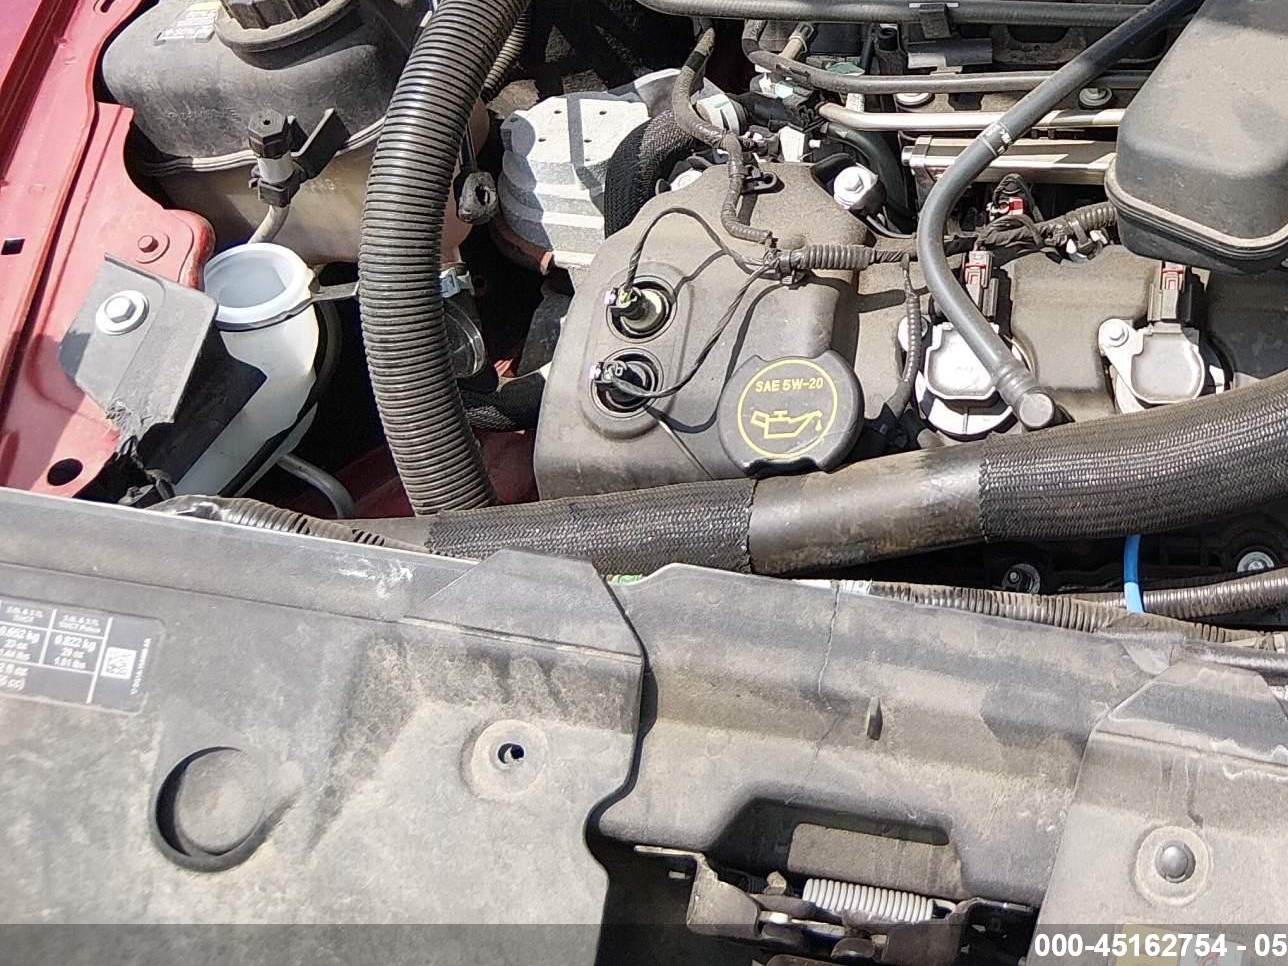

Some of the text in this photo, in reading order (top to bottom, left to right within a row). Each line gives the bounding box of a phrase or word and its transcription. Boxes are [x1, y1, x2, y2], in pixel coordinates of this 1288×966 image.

[755, 377, 824, 393] SAE 5W-20
[82, 639, 97, 652] kg
